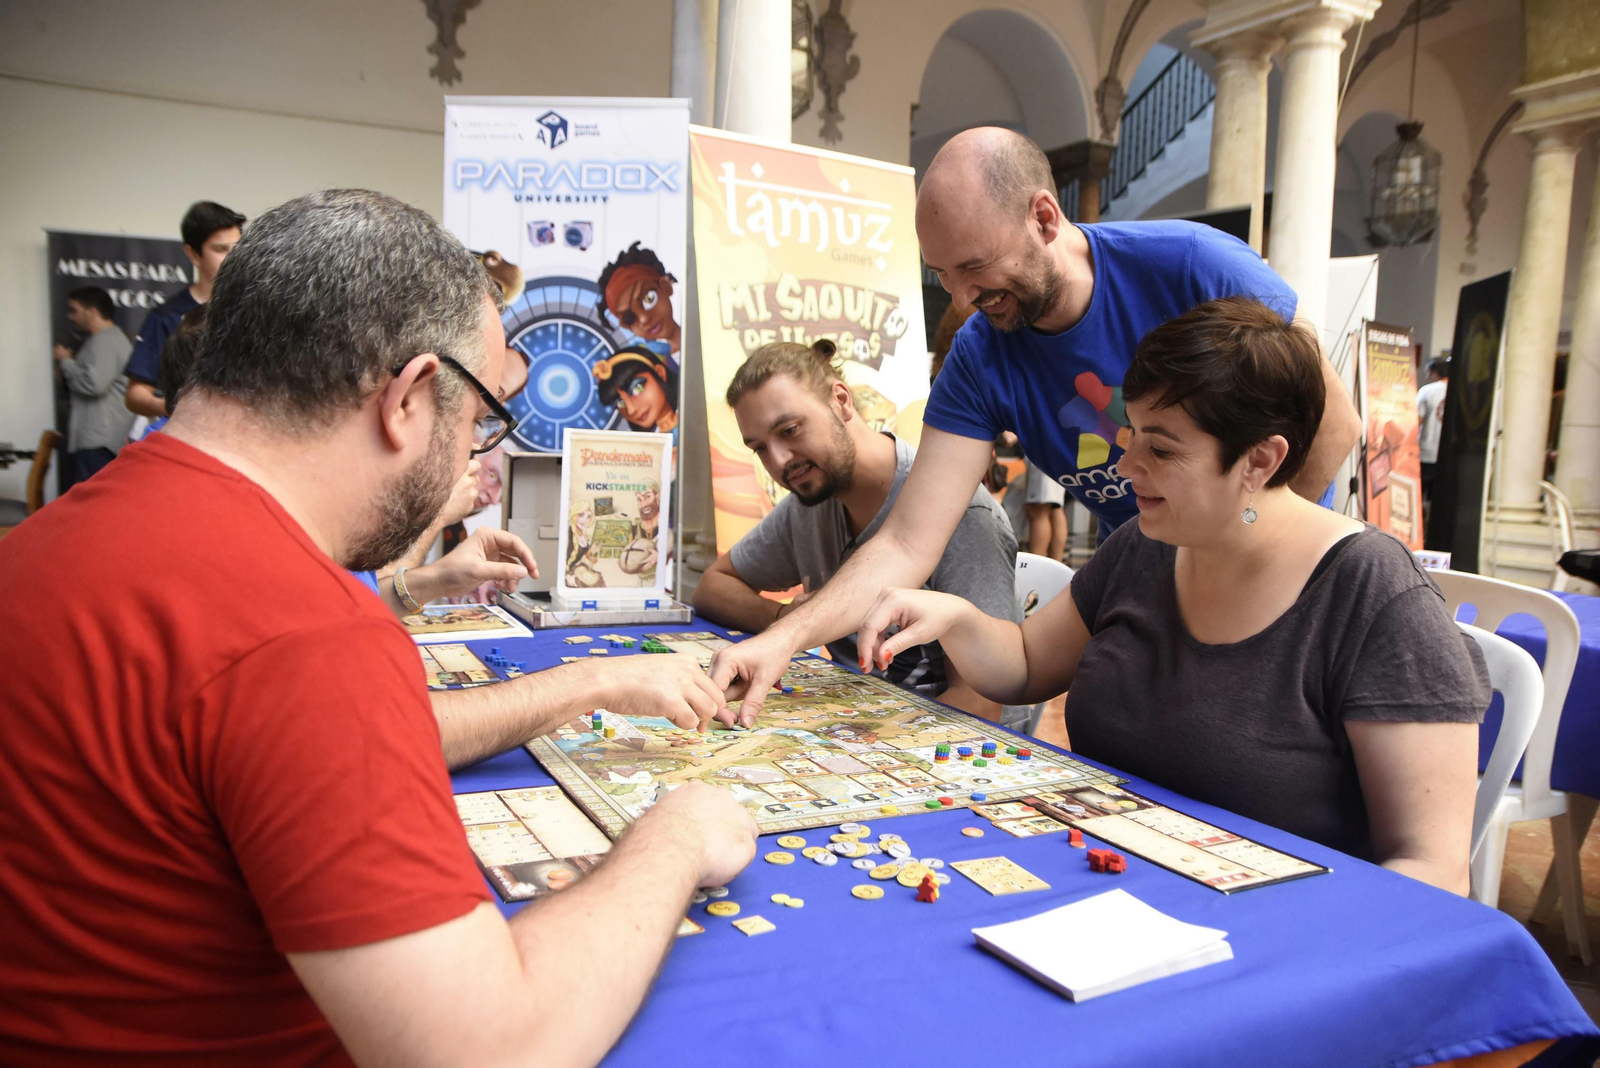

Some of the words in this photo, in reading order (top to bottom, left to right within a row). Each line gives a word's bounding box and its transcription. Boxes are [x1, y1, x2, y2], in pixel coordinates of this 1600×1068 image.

[455, 161, 679, 191] PARADOX
[514, 194, 609, 203] UNIVERSITY
[717, 161, 894, 253] tamuz
[831, 248, 873, 267] Games
[55, 257, 129, 279] MESAS
[129, 261, 189, 284] PARA
[107, 288, 167, 309] EGOS
[586, 482, 648, 492] KICKSTARTER
